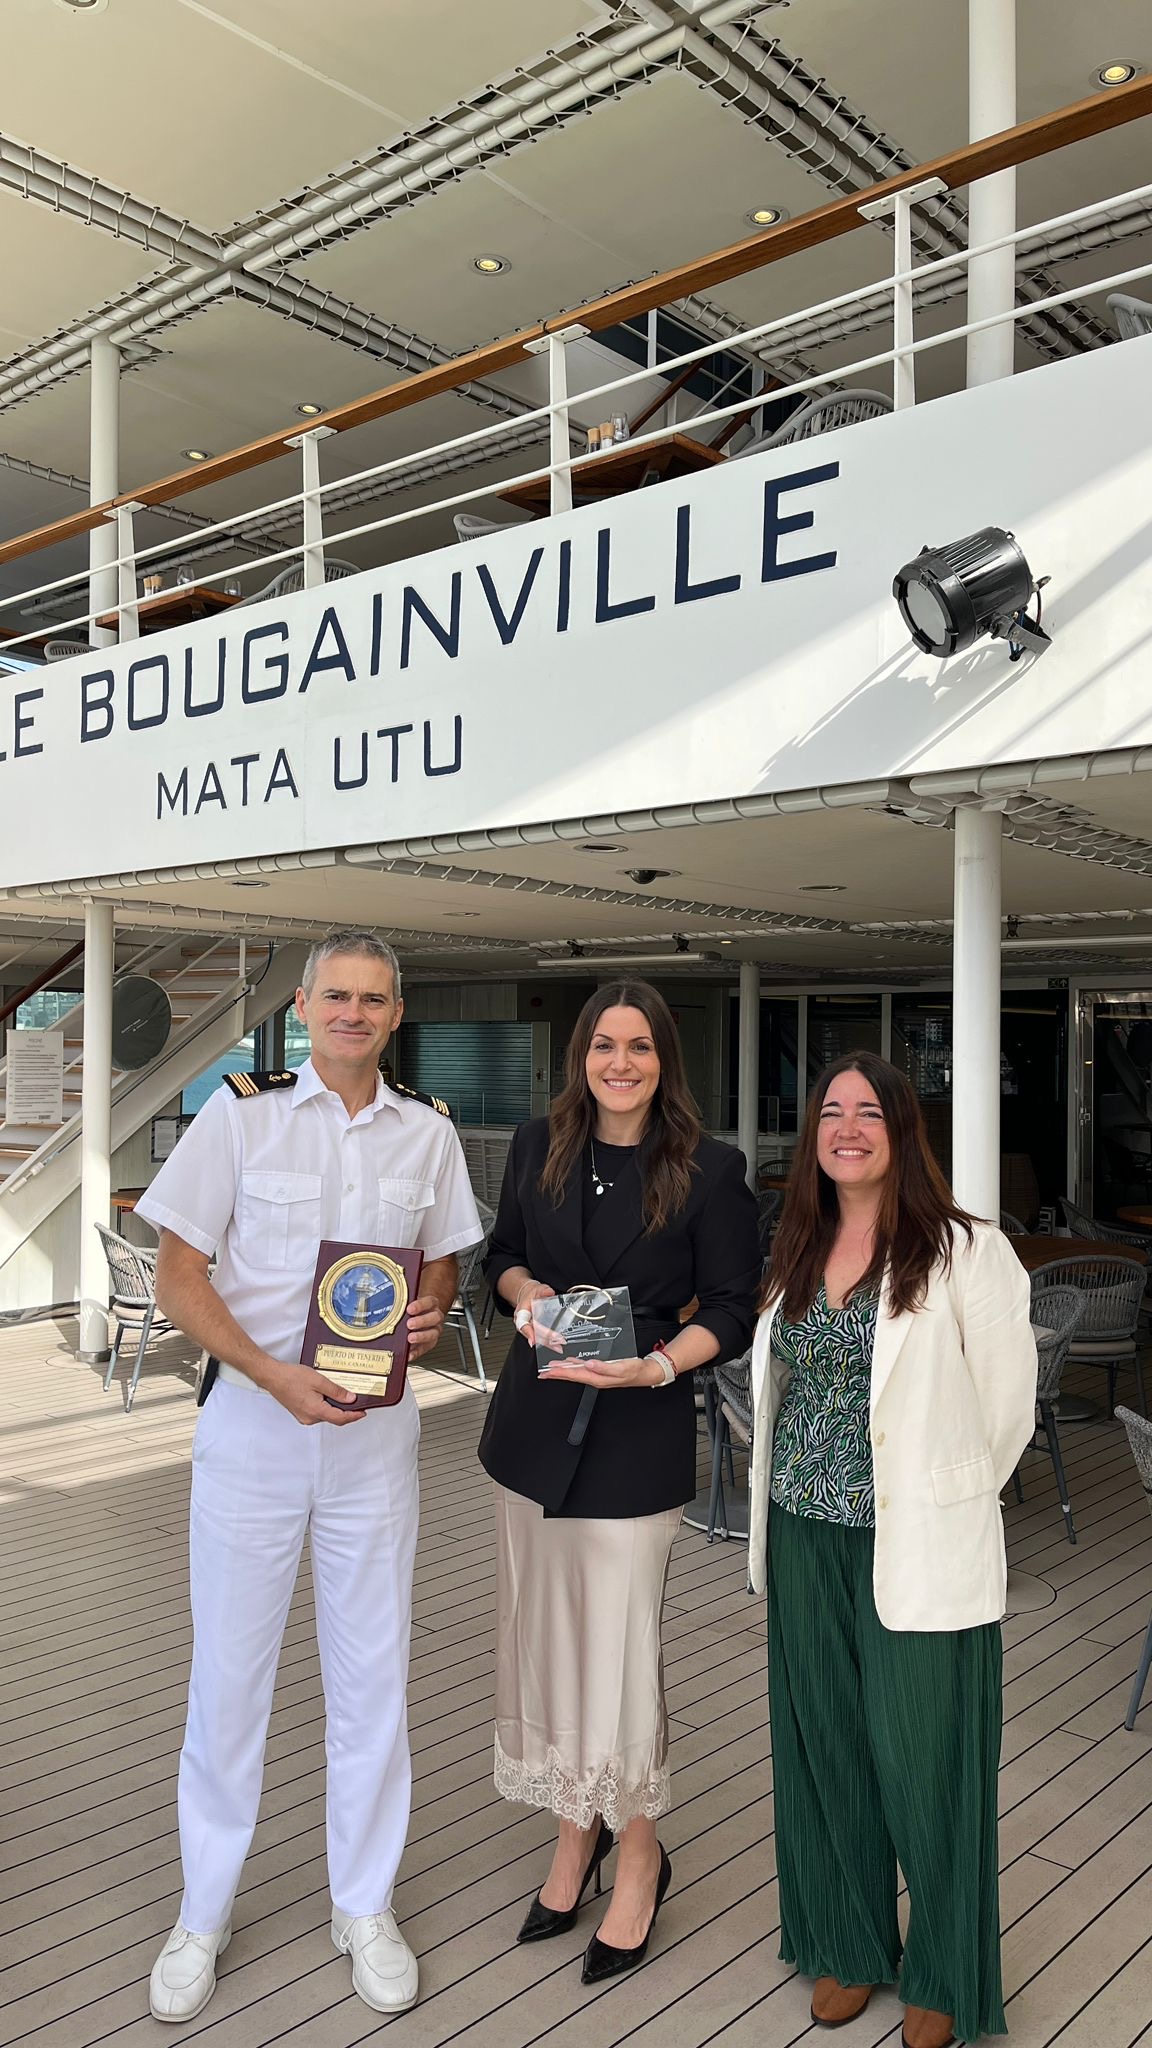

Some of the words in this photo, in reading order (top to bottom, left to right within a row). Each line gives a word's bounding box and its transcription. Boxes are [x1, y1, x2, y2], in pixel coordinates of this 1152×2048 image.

[0, 687, 44, 762] E
[80, 460, 841, 745] BOUGAINVILLE
[156, 748, 299, 821] MATA
[333, 714, 463, 791] UTU
[348, 1351, 355, 1360] DE
